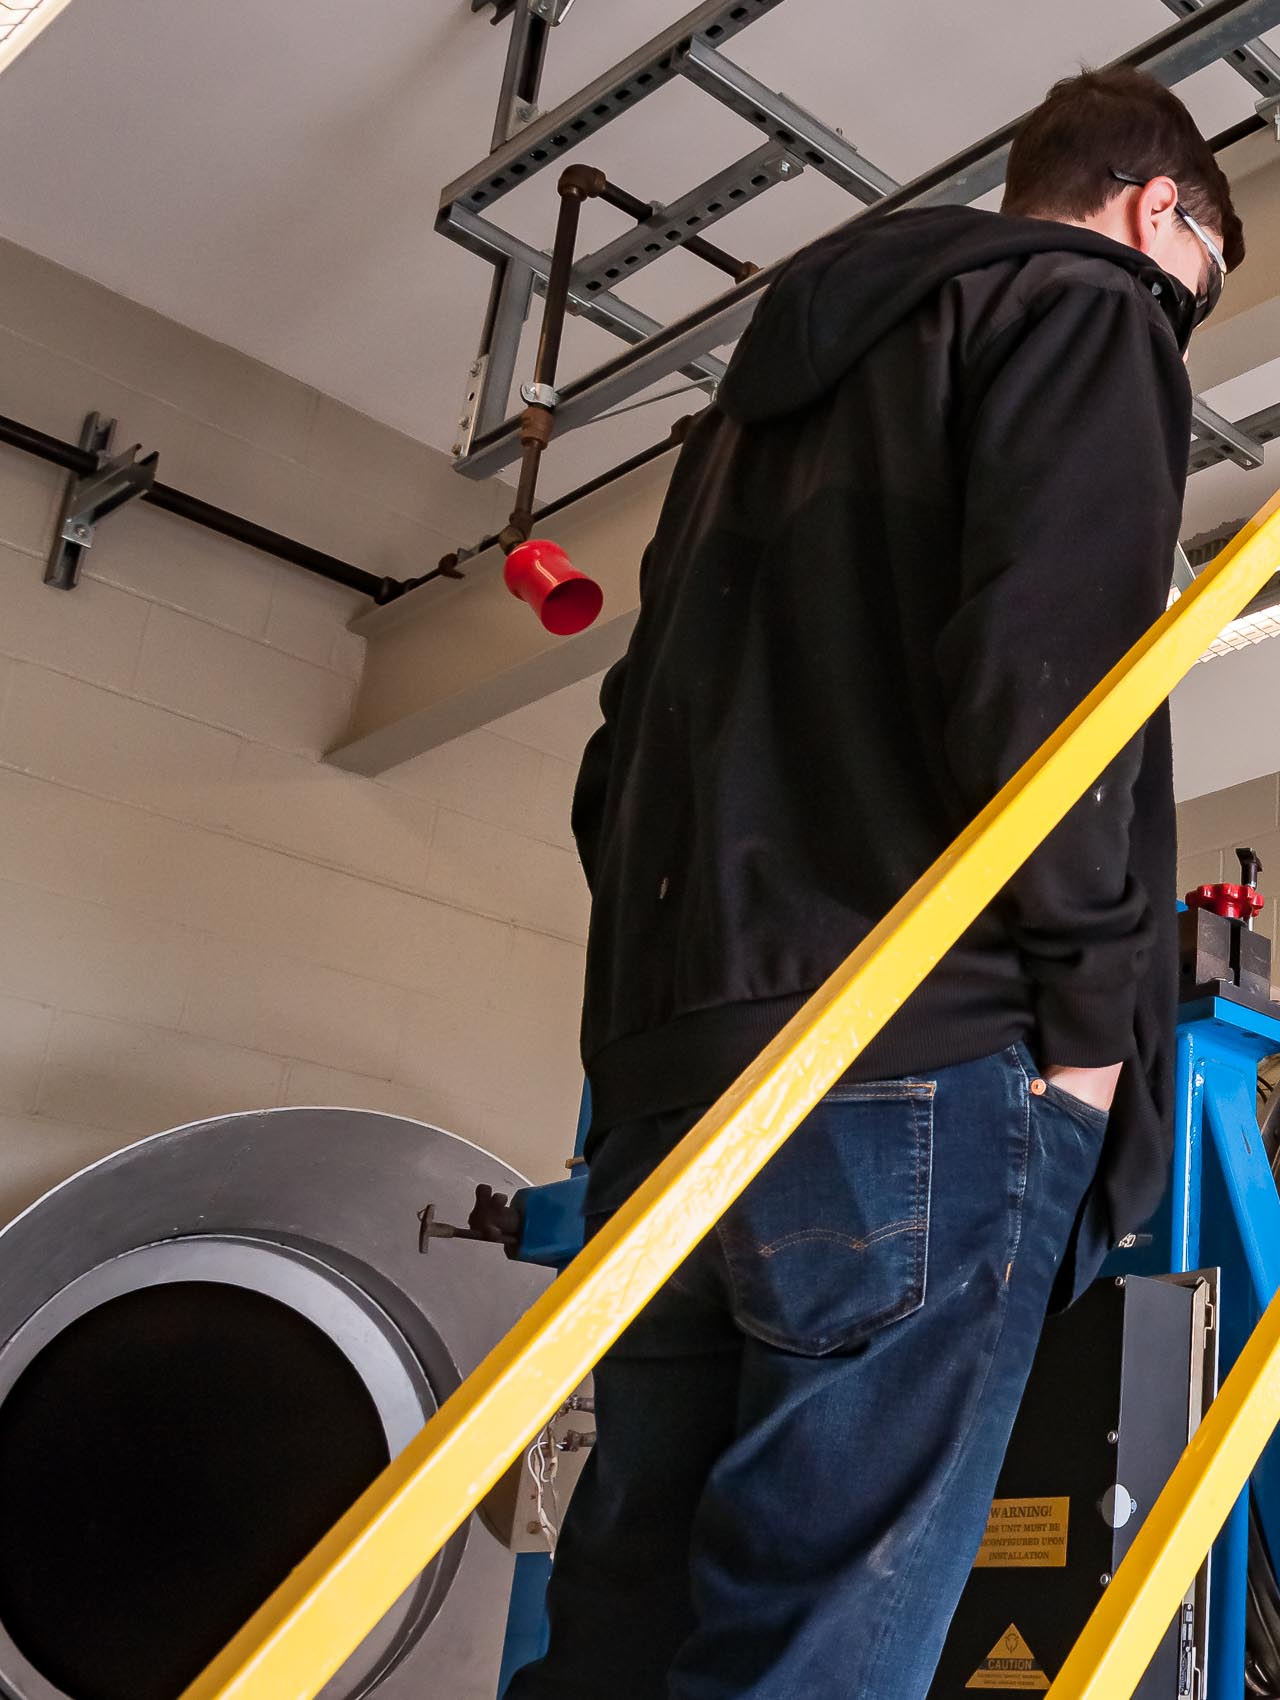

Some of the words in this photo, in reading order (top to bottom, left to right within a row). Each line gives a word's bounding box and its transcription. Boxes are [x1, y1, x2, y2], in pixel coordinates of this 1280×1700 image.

[990, 1505, 1053, 1519] WARNING!
[985, 1524, 1000, 1533] HIS
[1001, 1524, 1022, 1533] UNIT
[1023, 1523, 1048, 1532] MUST
[1049, 1522, 1061, 1532] BE
[1041, 1537, 1065, 1546] UPON
[987, 1659, 1032, 1670] CAUTION
